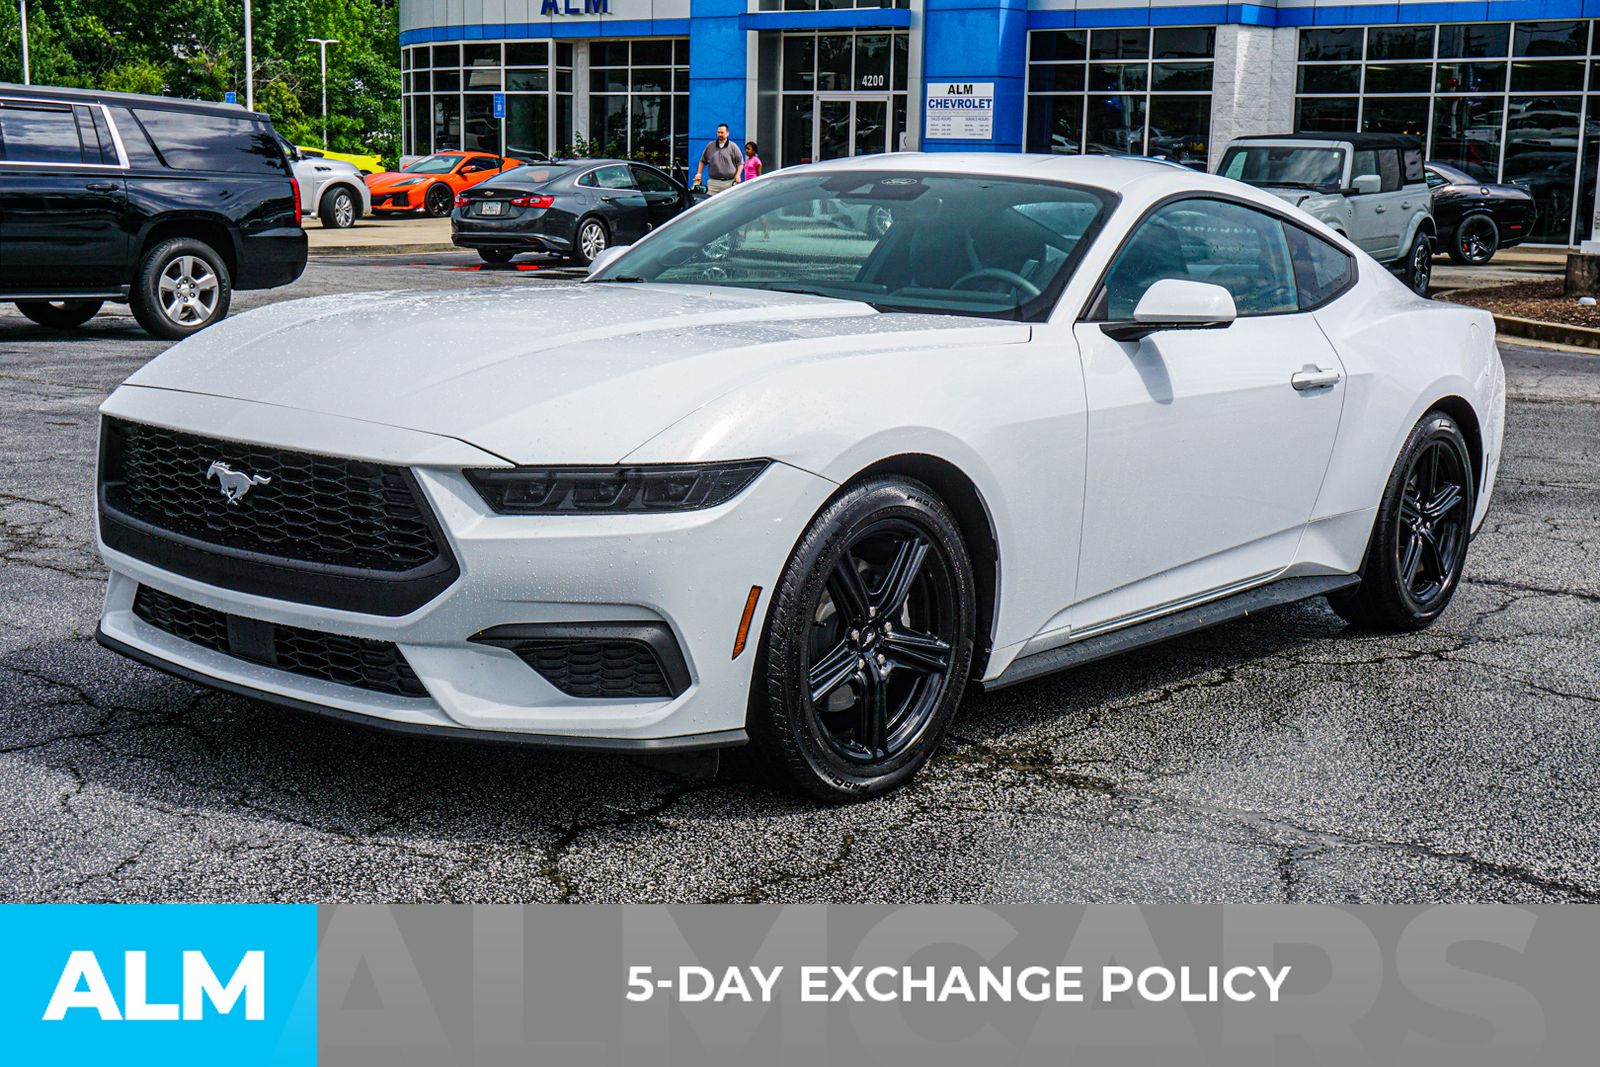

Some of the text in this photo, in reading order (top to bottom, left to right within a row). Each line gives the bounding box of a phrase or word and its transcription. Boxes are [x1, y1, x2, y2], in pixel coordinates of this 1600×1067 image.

[541, 0, 608, 15] ALM
[861, 74, 884, 87] 4200
[947, 84, 973, 95] ALM
[928, 98, 992, 109] CHEVROLET
